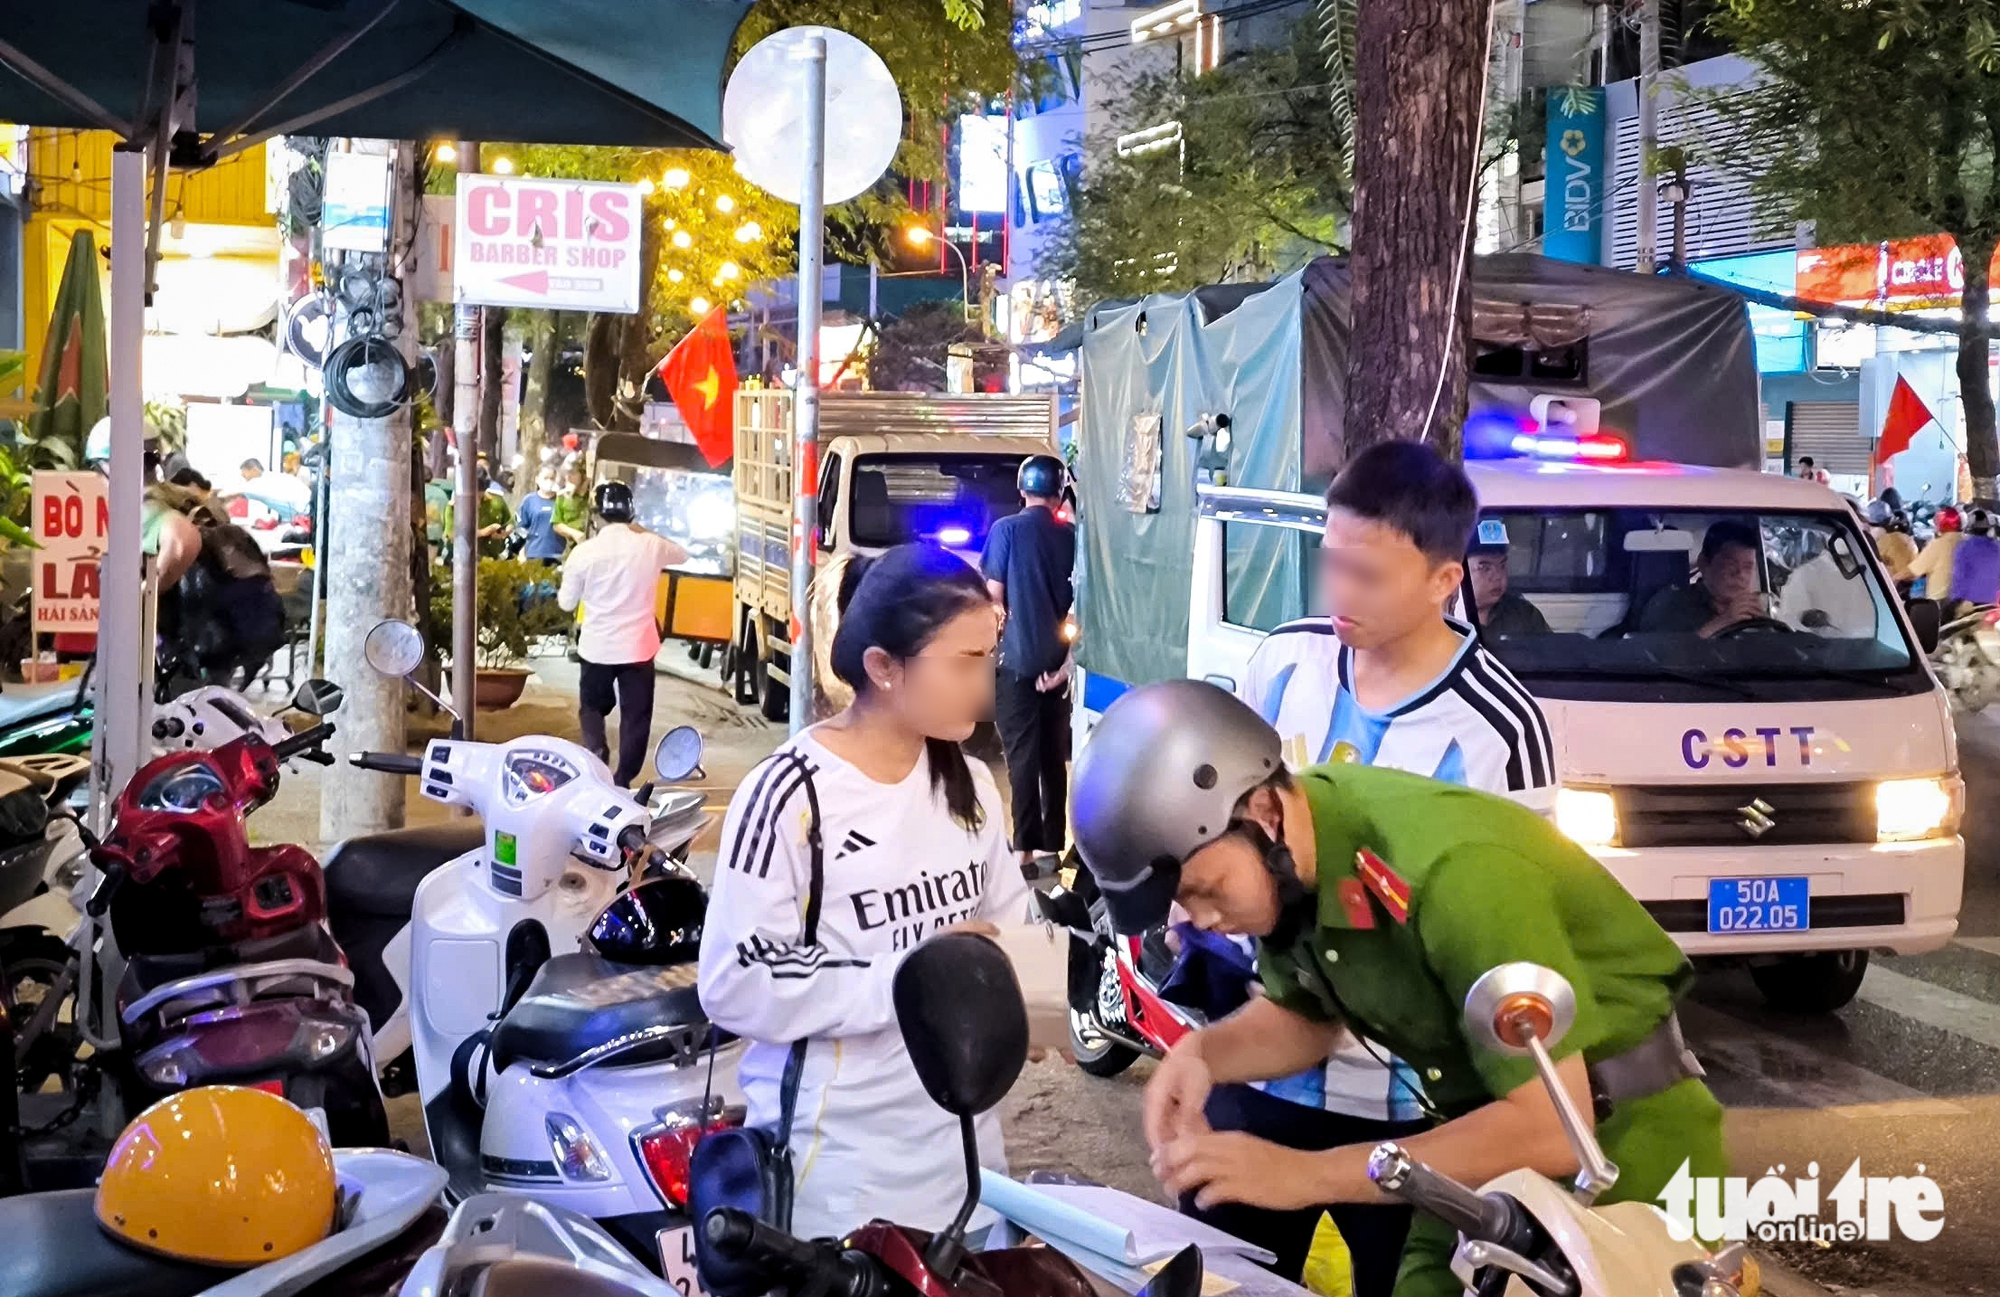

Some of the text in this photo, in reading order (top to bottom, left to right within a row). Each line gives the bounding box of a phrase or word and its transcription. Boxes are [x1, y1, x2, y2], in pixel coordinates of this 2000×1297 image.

[468, 186, 630, 242] CRIS
[1564, 156, 1591, 232] BIDV
[470, 242, 627, 268] BARBER SHOP
[44, 480, 84, 538] BÒ
[1682, 727, 1814, 769] CSTT
[1737, 880, 1779, 903] 50A
[1719, 905, 1798, 929] 022.05
